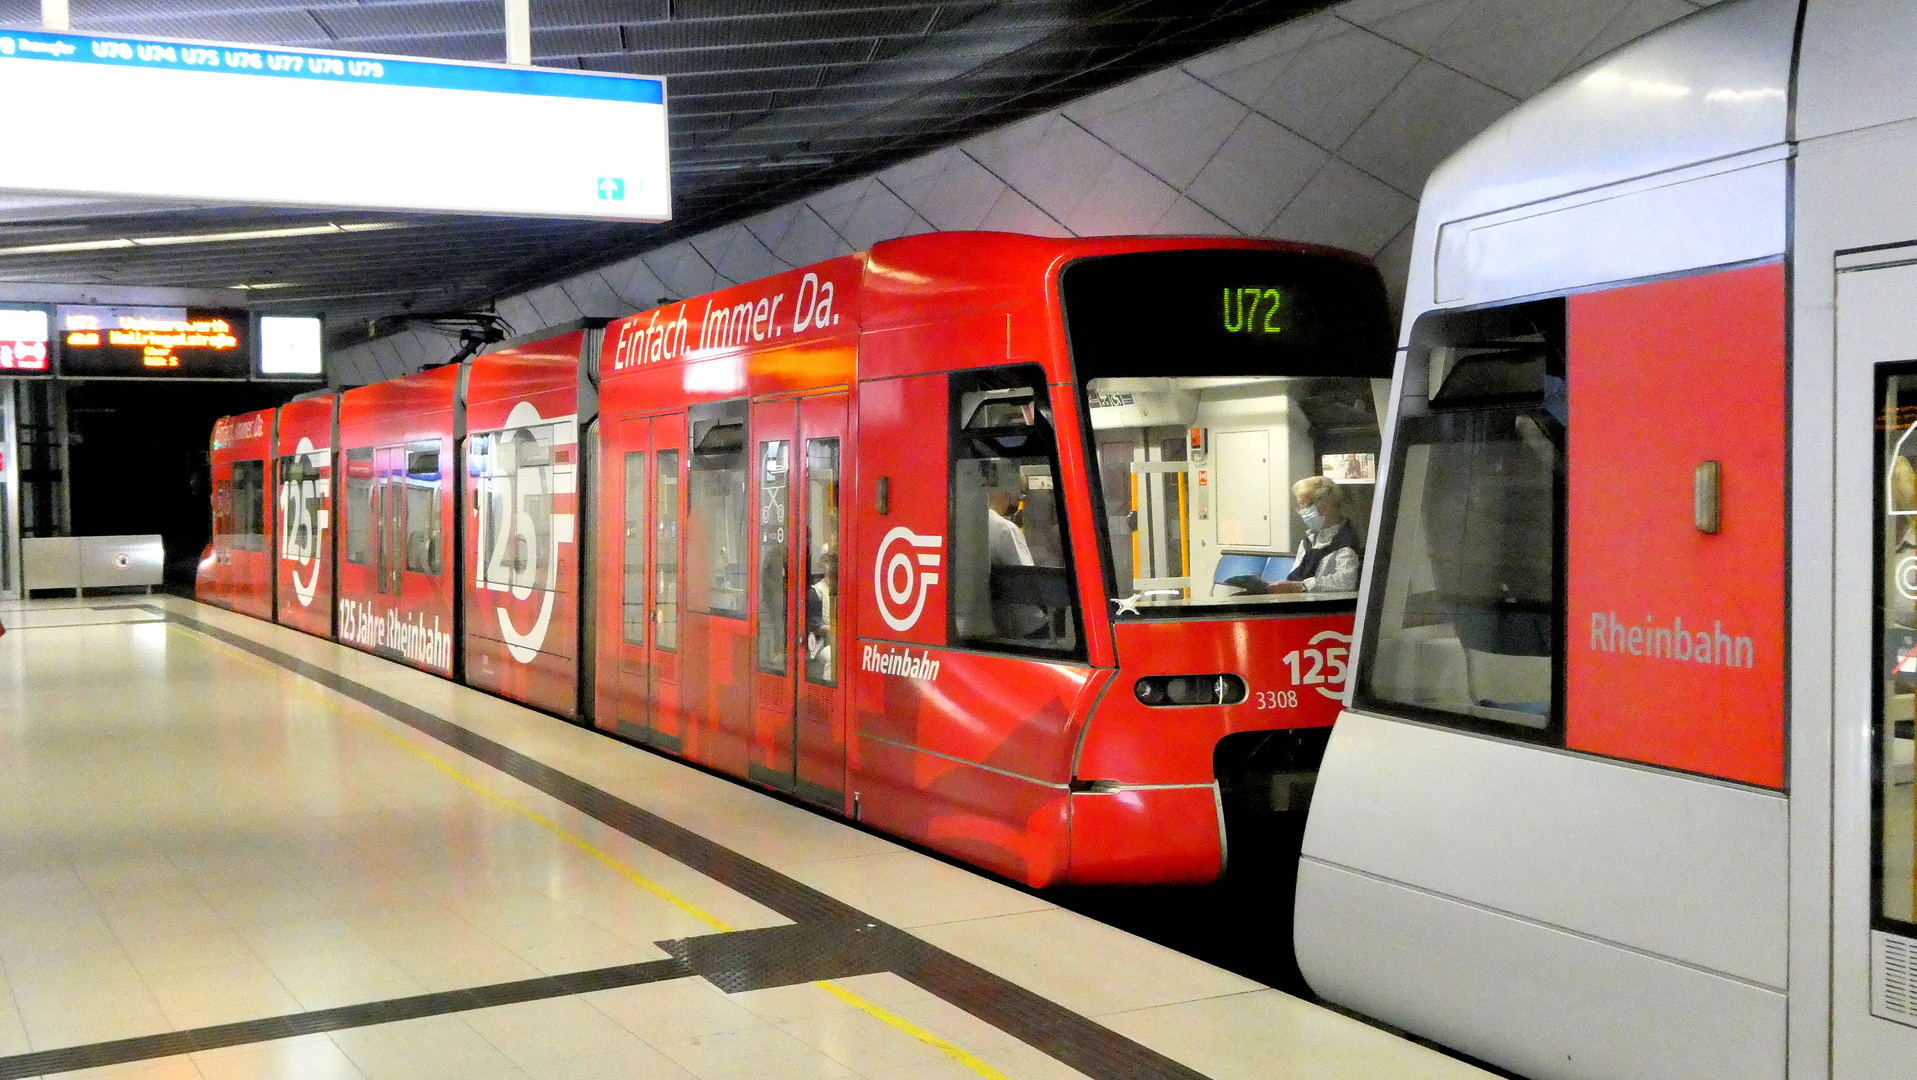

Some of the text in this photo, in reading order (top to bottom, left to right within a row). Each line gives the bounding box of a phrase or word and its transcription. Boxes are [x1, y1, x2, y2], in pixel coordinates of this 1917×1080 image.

[137, 44, 177, 62] U74
[182, 47, 220, 66] U75
[224, 51, 263, 69] U76
[268, 54, 303, 72] U77
[308, 57, 345, 76] U78
[348, 60, 384, 78] U79
[614, 272, 839, 370] Einfach. Immer. Da.
[1223, 287, 1282, 333] U72
[280, 479, 315, 566] 125
[473, 467, 543, 601] 125
[339, 598, 450, 670] 125 Jahre Rheinbahn
[1591, 611, 1755, 668] Rheinbahn
[862, 645, 940, 681] Rheinbahn
[1282, 647, 1349, 685] 125
[1256, 690, 1298, 710] 3308
